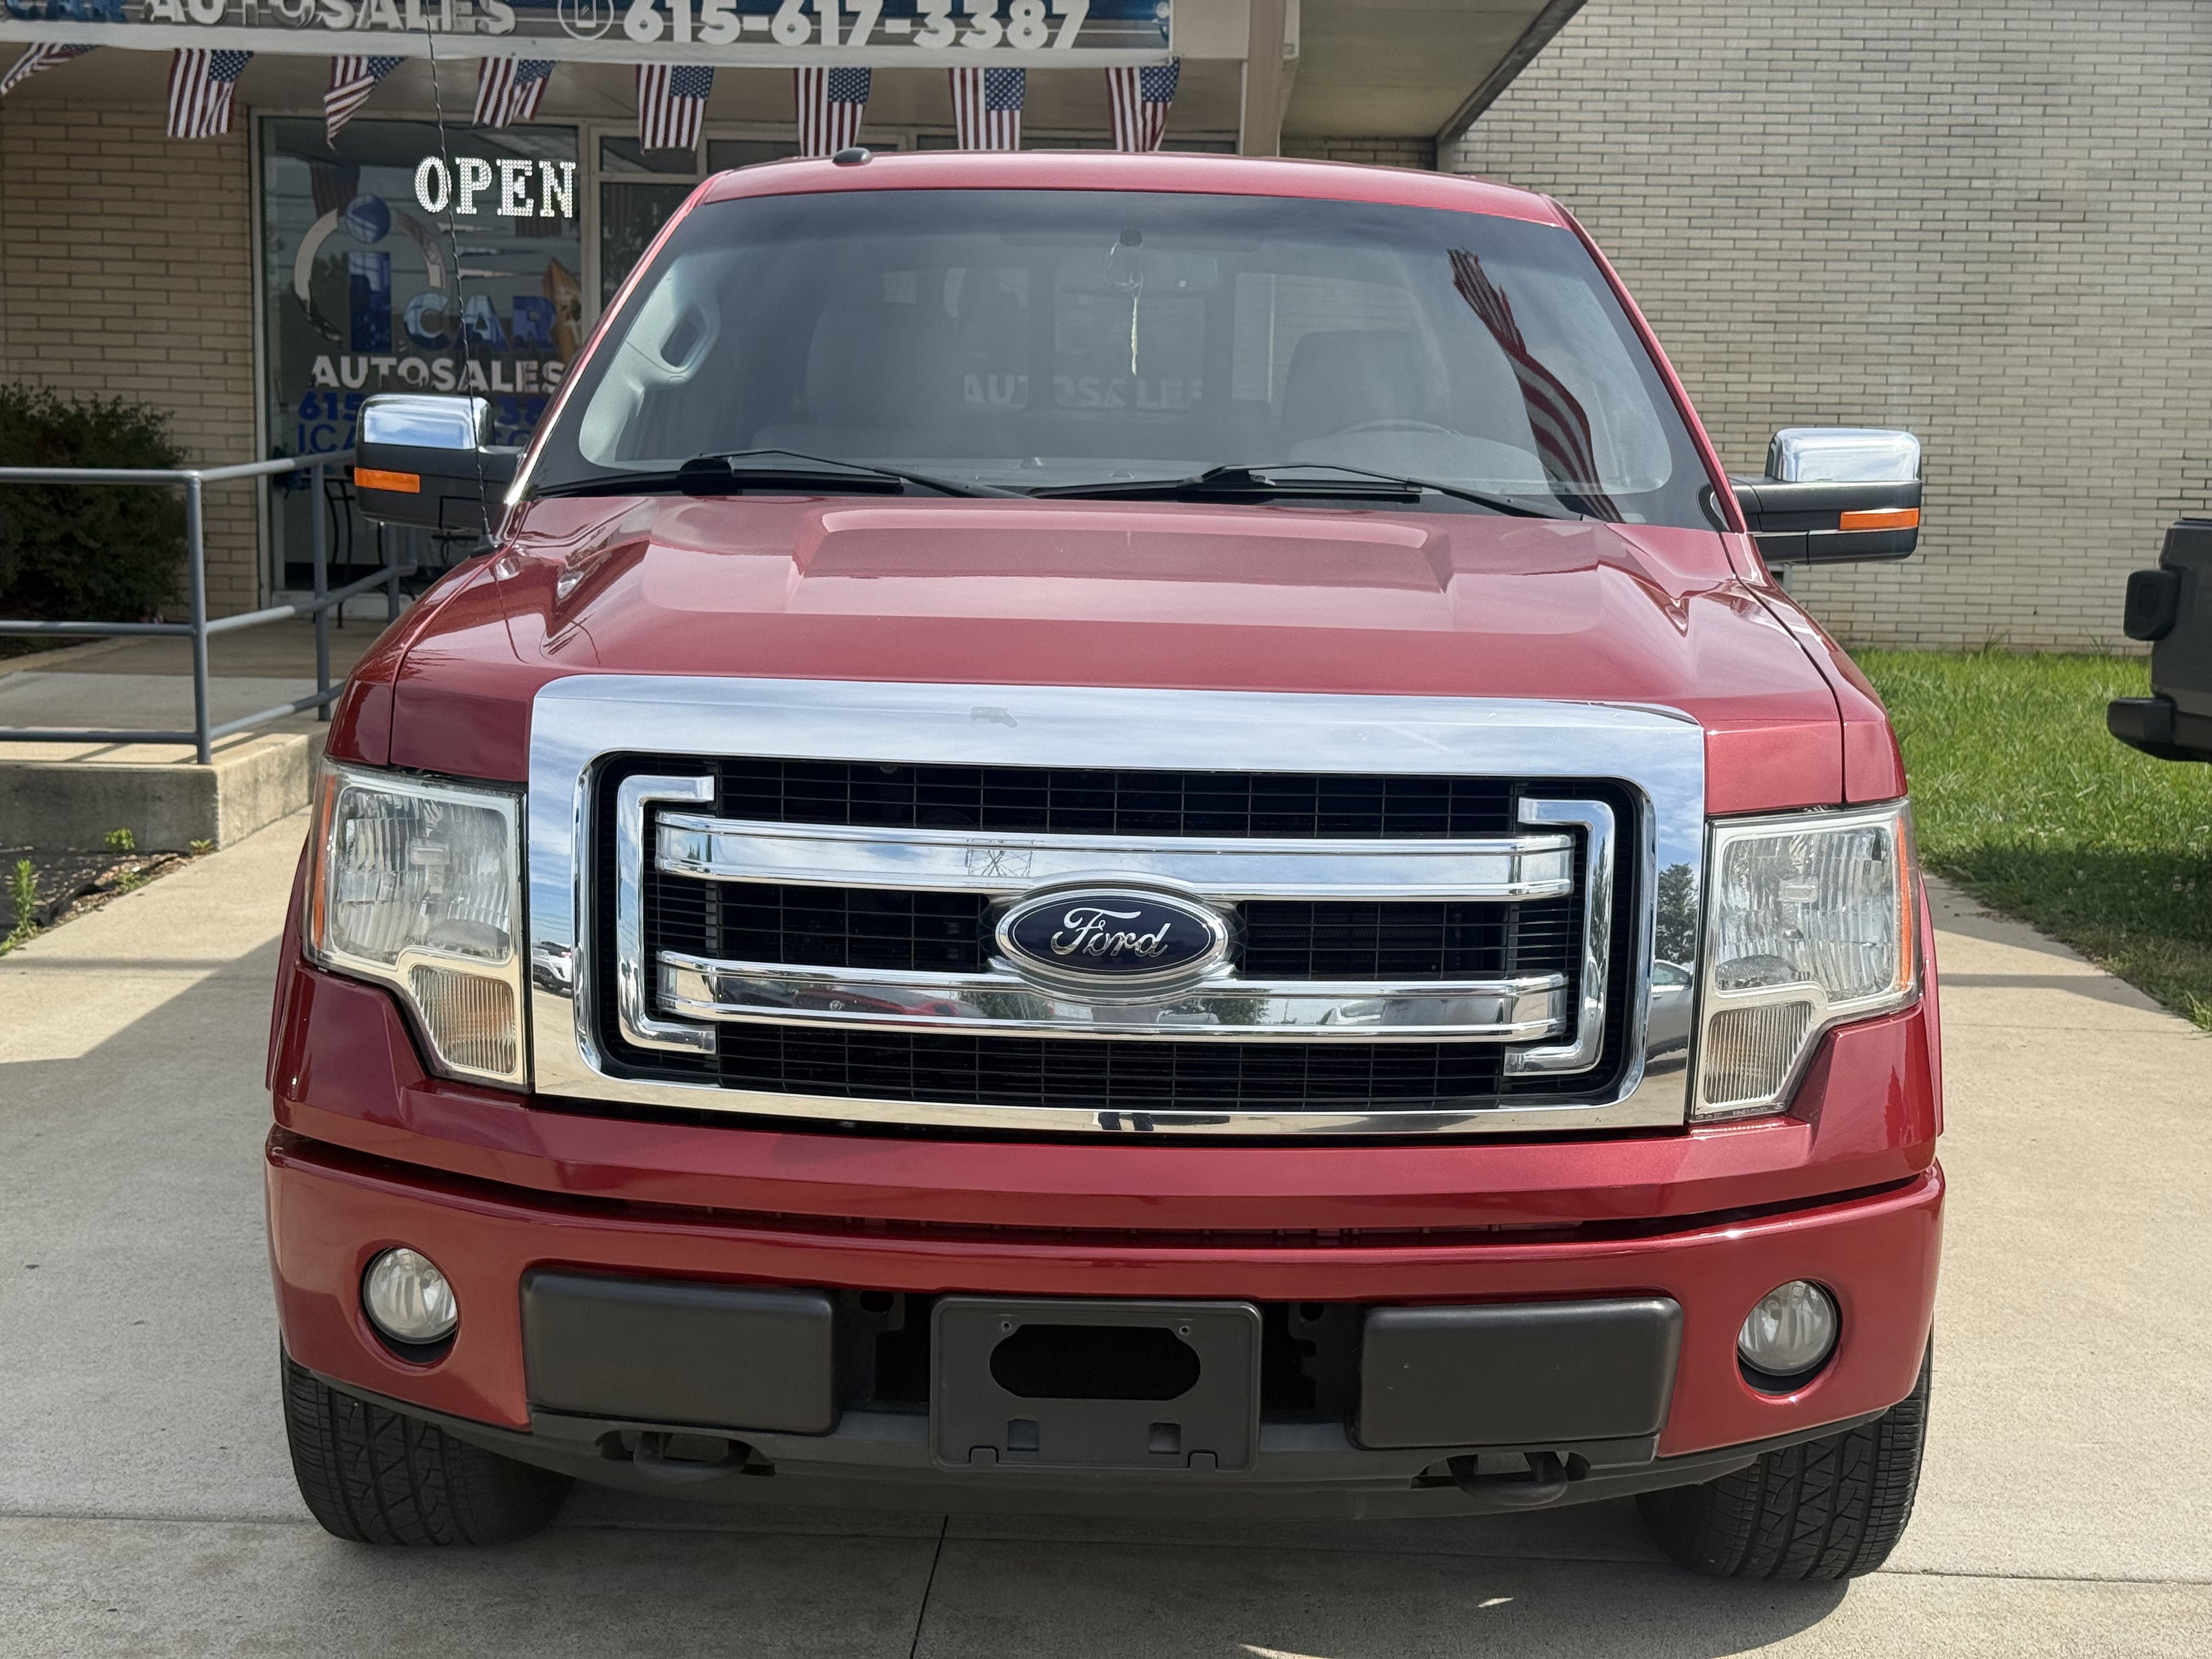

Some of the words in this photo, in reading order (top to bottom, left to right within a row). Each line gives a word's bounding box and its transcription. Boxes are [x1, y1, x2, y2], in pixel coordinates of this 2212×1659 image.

[623, 0, 1091, 50] 615-617-3387
[415, 156, 576, 218] OPEN
[403, 292, 556, 352] CAR
[310, 354, 567, 393] AUTOSALES
[1050, 907, 1172, 958] Ford
